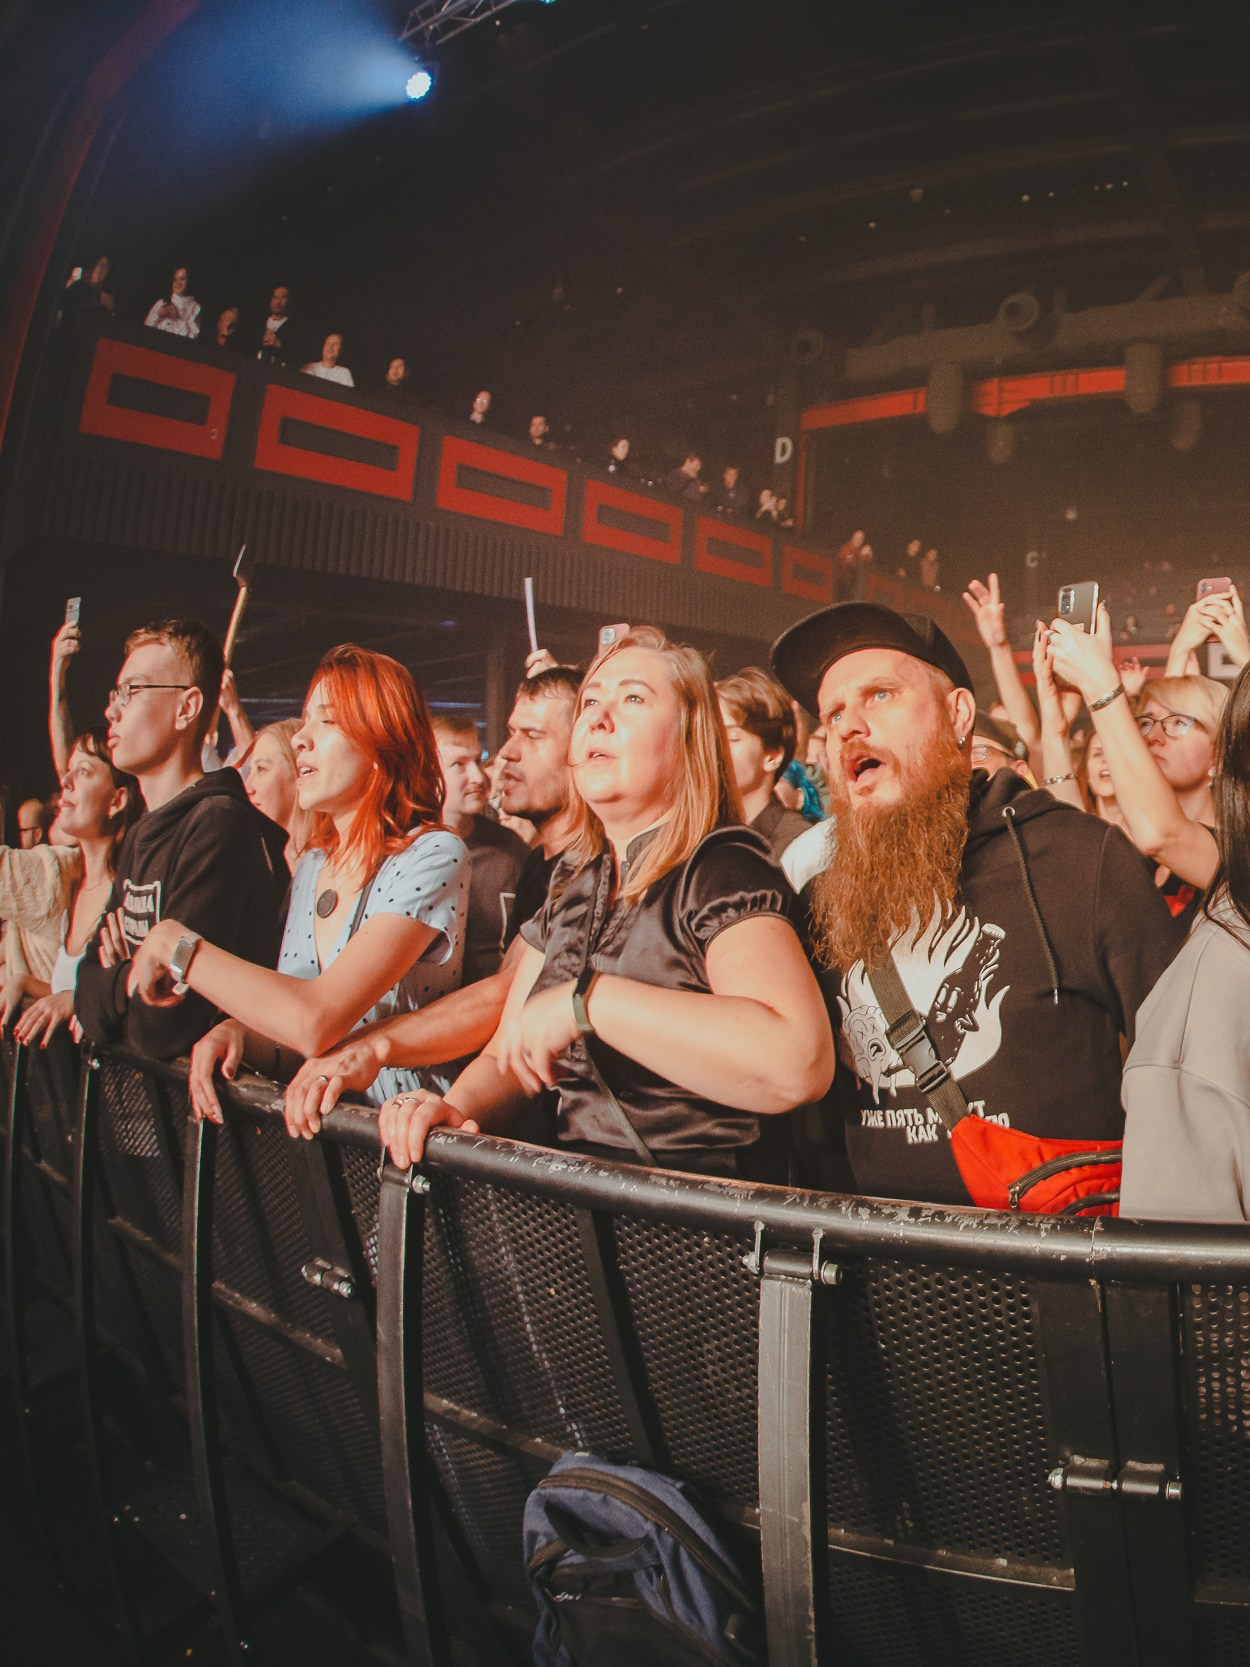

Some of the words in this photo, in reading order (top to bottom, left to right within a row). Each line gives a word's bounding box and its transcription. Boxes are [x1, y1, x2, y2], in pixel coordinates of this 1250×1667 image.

[774, 436, 793, 464] D
[861, 1108, 885, 1128] УЖЕ
[885, 1108, 924, 1128] ПЯТЬ
[906, 1123, 939, 1144] КАК
